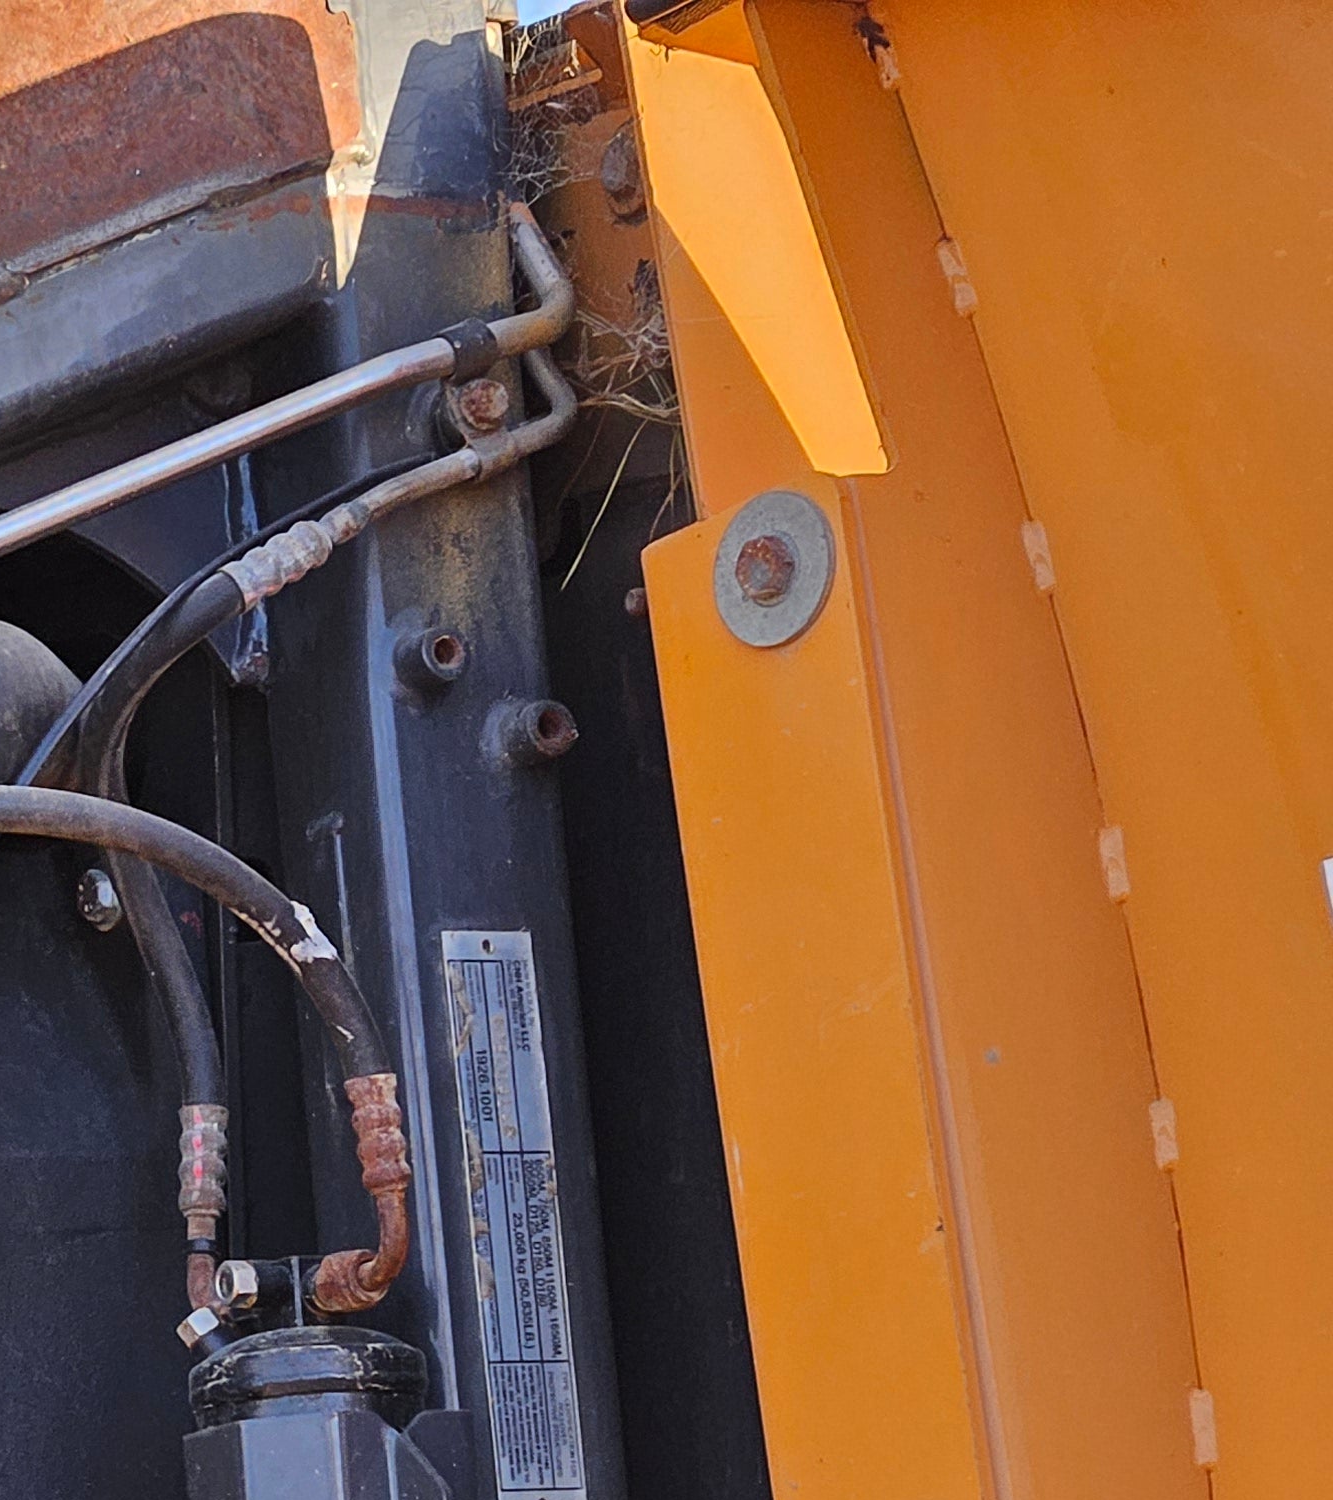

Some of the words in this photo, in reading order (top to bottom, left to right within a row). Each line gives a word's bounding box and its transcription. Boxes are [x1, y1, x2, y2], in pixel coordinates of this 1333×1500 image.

[515, 985, 527, 1027] America
[520, 1031, 530, 1052] LLC
[475, 1049, 494, 1121] 1926.1001
[514, 1258, 527, 1273] kg
